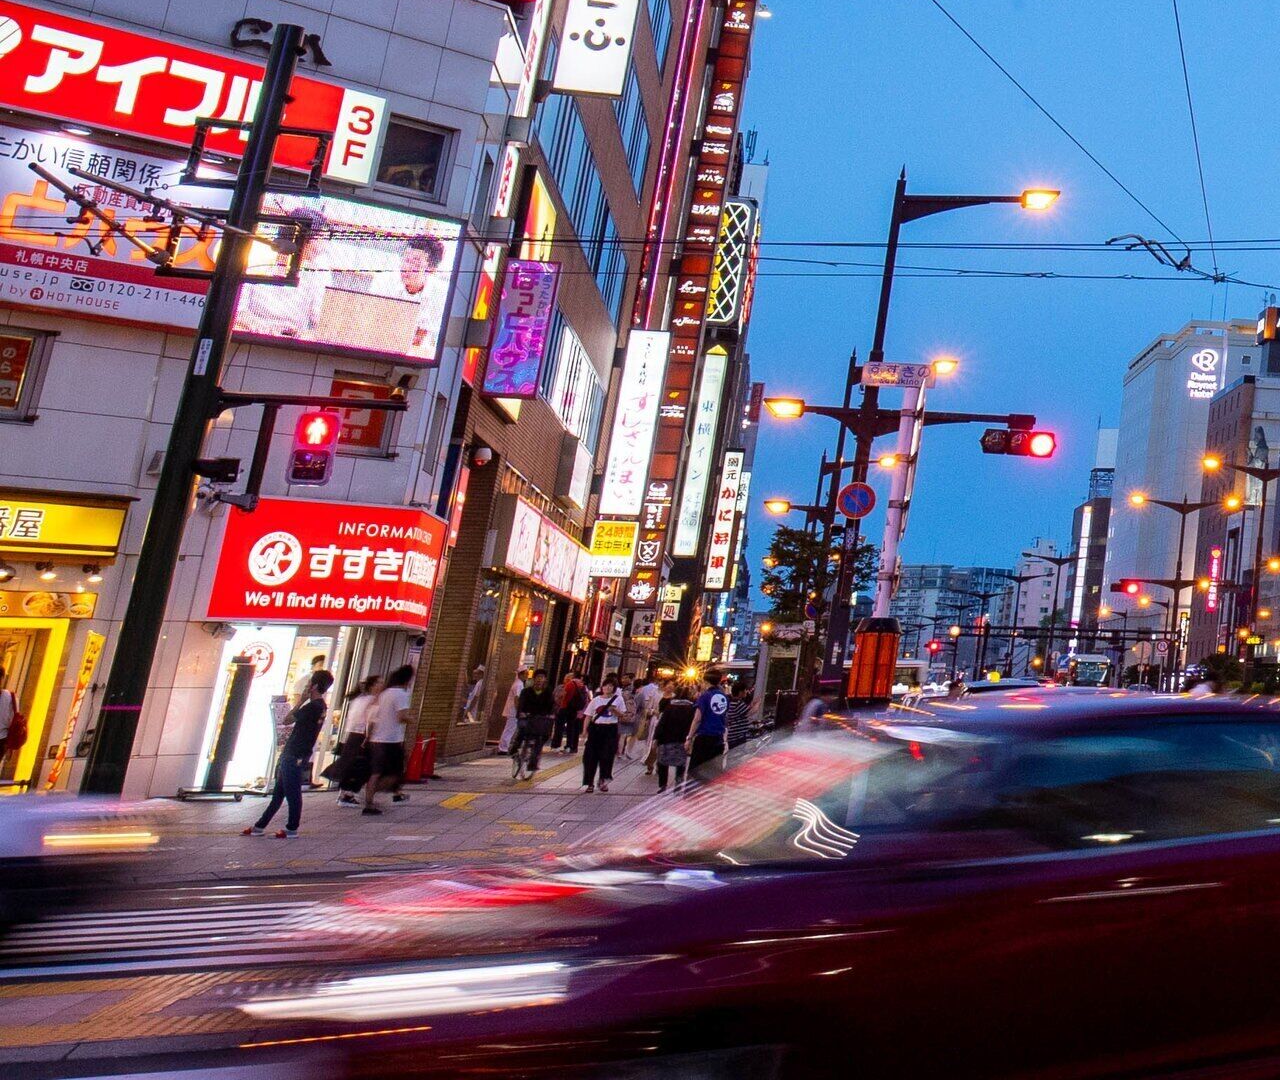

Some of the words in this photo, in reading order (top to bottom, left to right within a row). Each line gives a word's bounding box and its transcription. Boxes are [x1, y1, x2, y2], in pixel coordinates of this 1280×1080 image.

[15, 249, 89, 273] 札幌中央店
[46, 291, 73, 304] HOT
[76, 295, 120, 310] HOUSE
[97, 280, 205, 308] 0120-211-446
[870, 363, 931, 378] すすきの
[597, 525, 635, 539] 24時間
[710, 486, 736, 569] かに将軍
[245, 590, 284, 607] We'll
[287, 592, 316, 609] find
[320, 594, 345, 610] the
[348, 595, 382, 613] right
